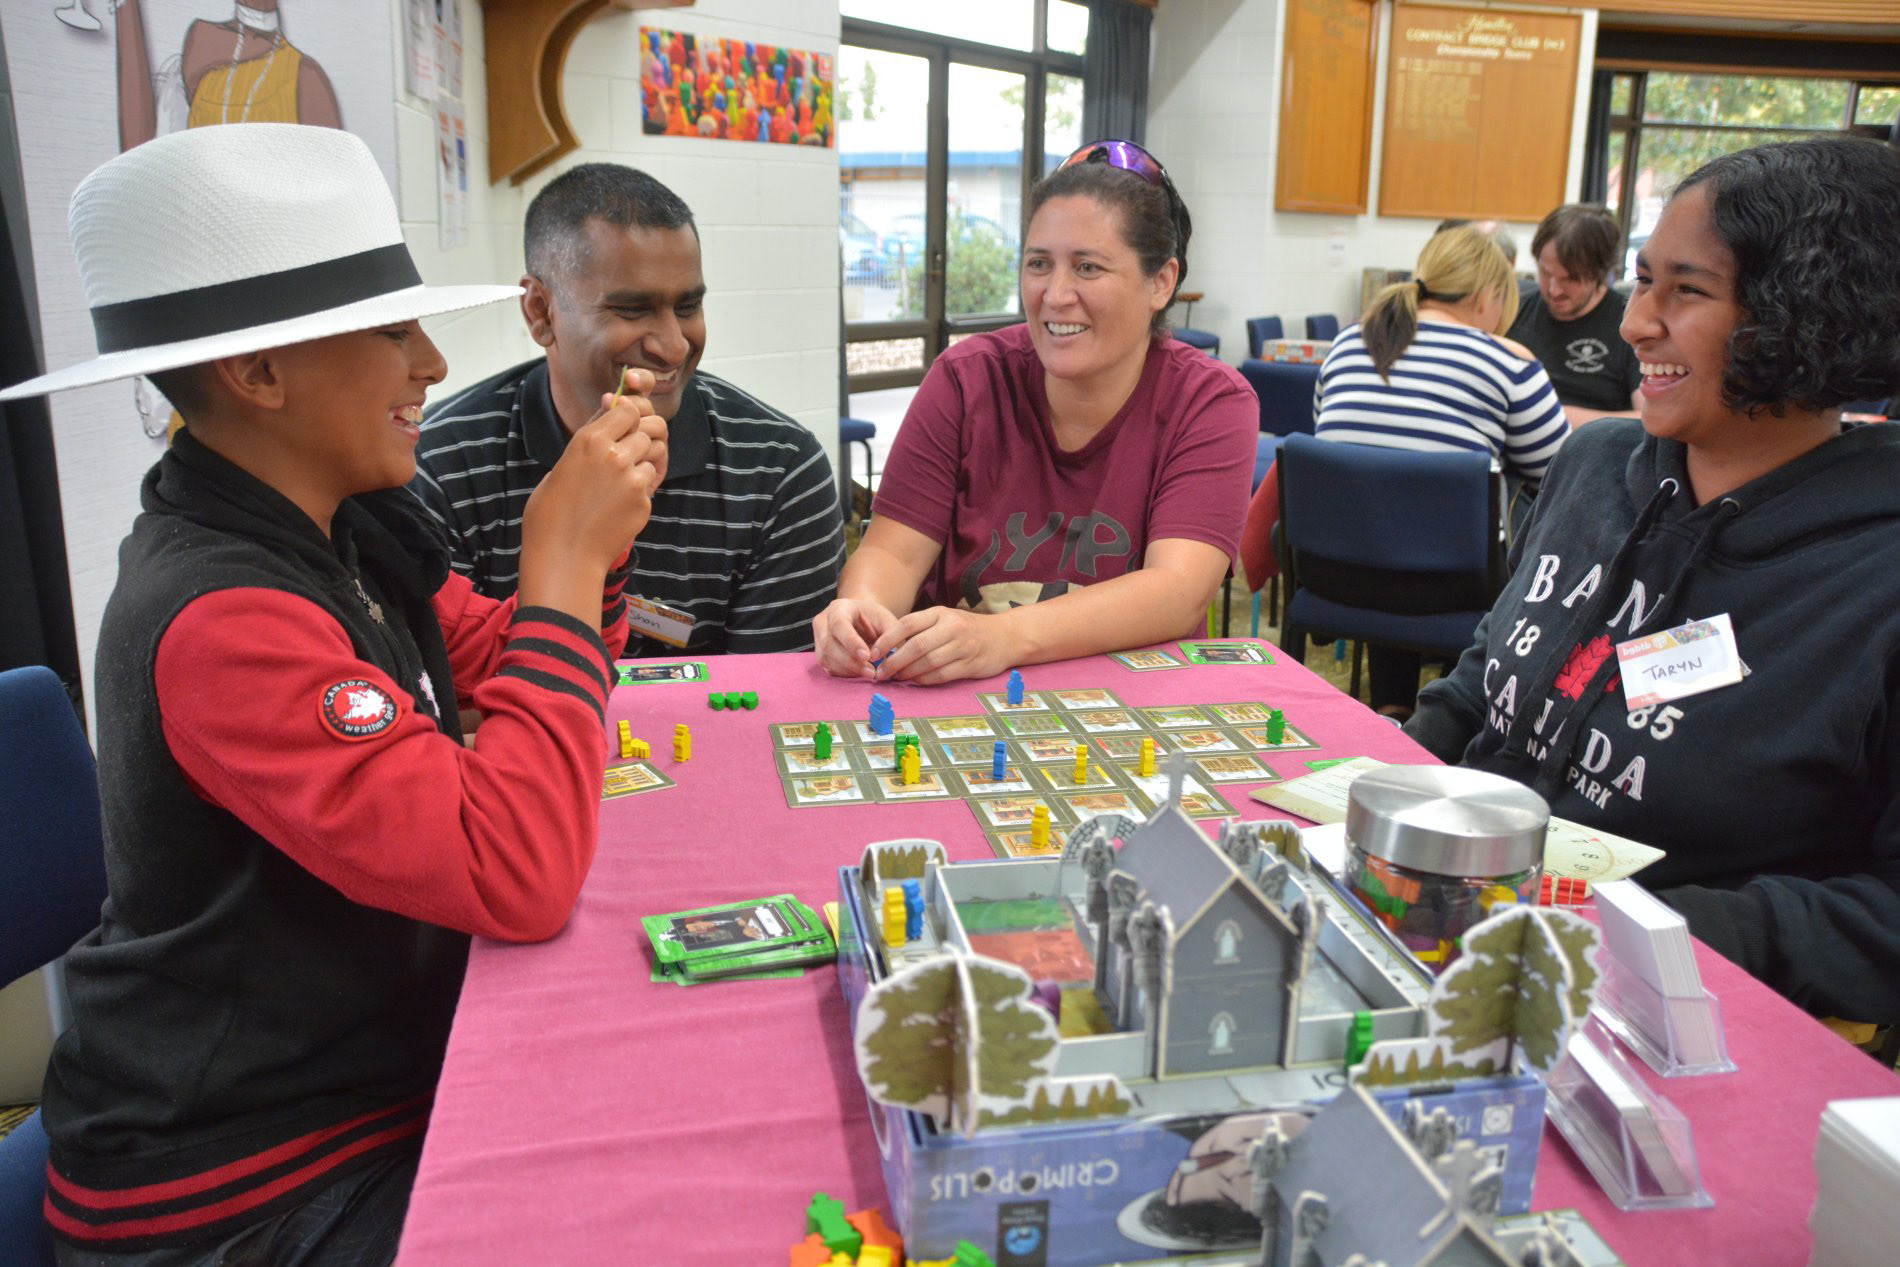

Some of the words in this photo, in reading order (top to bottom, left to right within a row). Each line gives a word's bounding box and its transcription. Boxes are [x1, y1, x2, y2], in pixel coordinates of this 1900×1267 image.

[1511, 36, 1540, 49] CLUB
[1505, 617, 1541, 657] 18
[1642, 656, 1702, 680] TARYN
[345, 720, 386, 733] weather
[384, 703, 394, 720] gear
[1566, 766, 1613, 810] PARK
[929, 1158, 1119, 1201] CRIMOPOLIS
